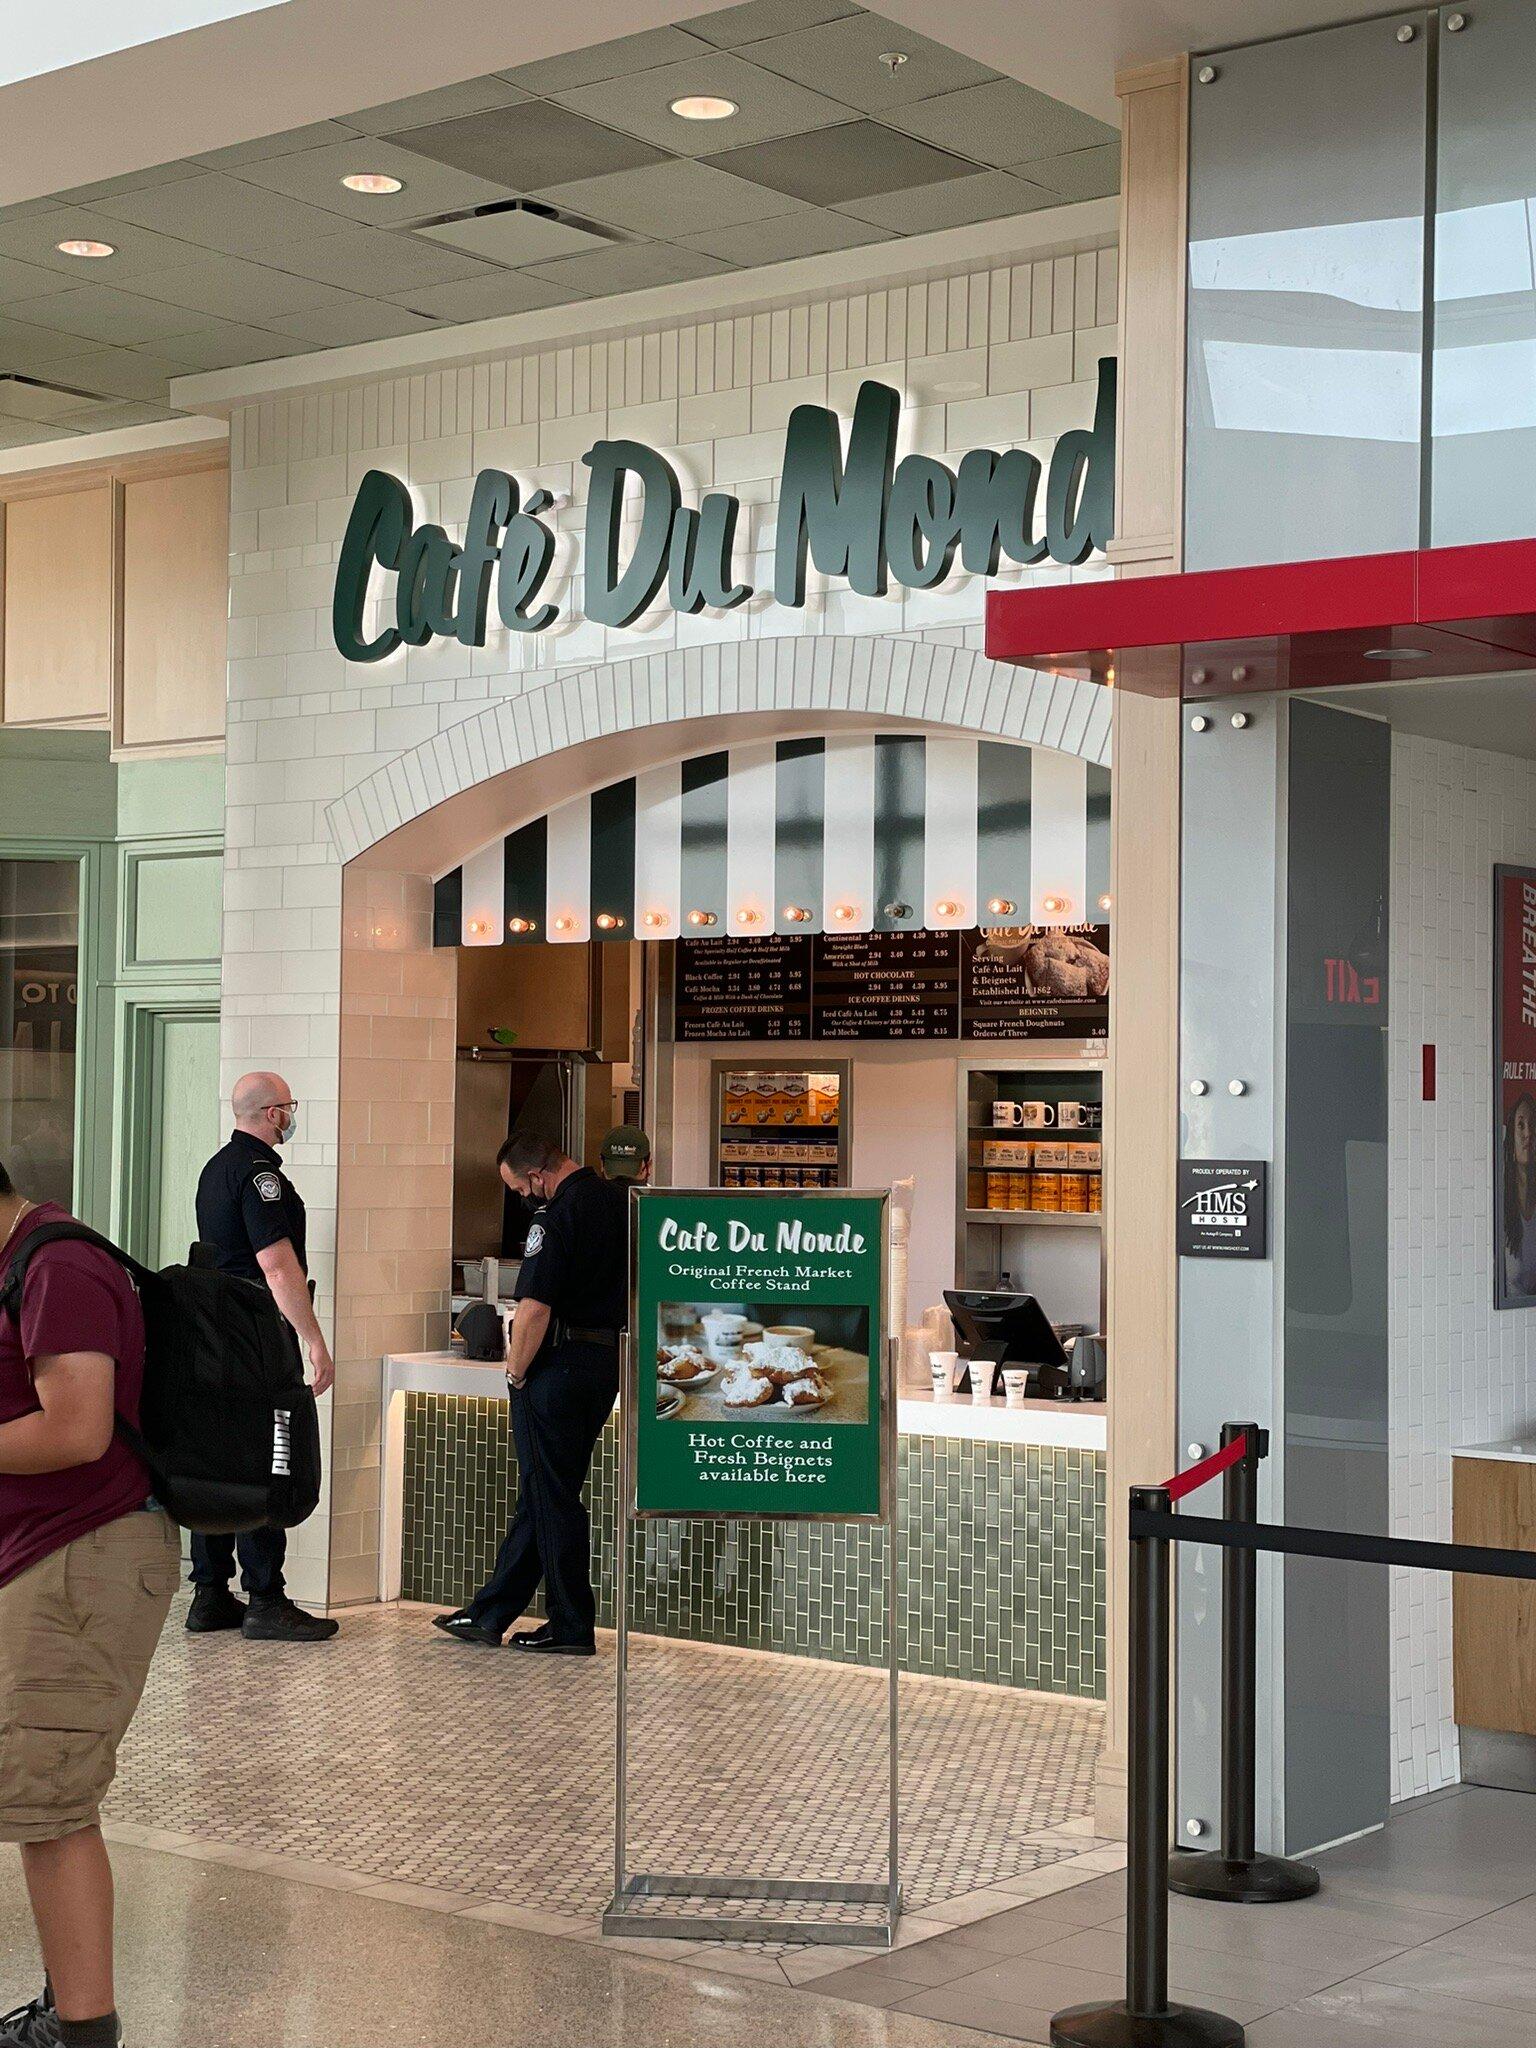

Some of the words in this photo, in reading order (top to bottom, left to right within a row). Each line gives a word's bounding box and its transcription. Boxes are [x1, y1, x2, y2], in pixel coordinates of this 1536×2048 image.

[333, 468, 559, 663] Café
[581, 440, 754, 628] Du
[972, 955, 1004, 963] Serving
[870, 971, 915, 979] CHOCOLATE
[973, 965, 990, 973] Café
[993, 965, 1004, 973] Au
[1006, 964, 1022, 972] Lait
[982, 976, 1016, 985] Beignets
[972, 987, 1019, 996] Established
[1033, 986, 1051, 994] 1862
[702, 1006, 728, 1014] FROZEN
[1019, 1008, 1058, 1016] BEIGNETS
[973, 1021, 997, 1029] Square
[1092, 1028, 1106, 1036] 3.40
[1503, 1061, 1524, 1080] RULE
[1525, 1061, 1536, 1080] TH
[1196, 1192, 1246, 1213] HMS
[659, 1217, 720, 1253] Cafe
[728, 1219, 768, 1253] Du
[776, 1219, 867, 1255] Monde
[669, 1264, 730, 1278] Original
[735, 1265, 789, 1278] French
[795, 1266, 852, 1279] Market
[710, 1278, 761, 1290] Coffee
[766, 1279, 810, 1291] Stand
[271, 1408, 291, 1476] PUMA
[688, 1433, 725, 1448] Hot
[731, 1434, 794, 1450] Coffee
[800, 1437, 833, 1450] and
[694, 1451, 747, 1465] Fresh
[753, 1451, 833, 1470] Beignets
[699, 1468, 779, 1482] available
[785, 1469, 826, 1484] here
